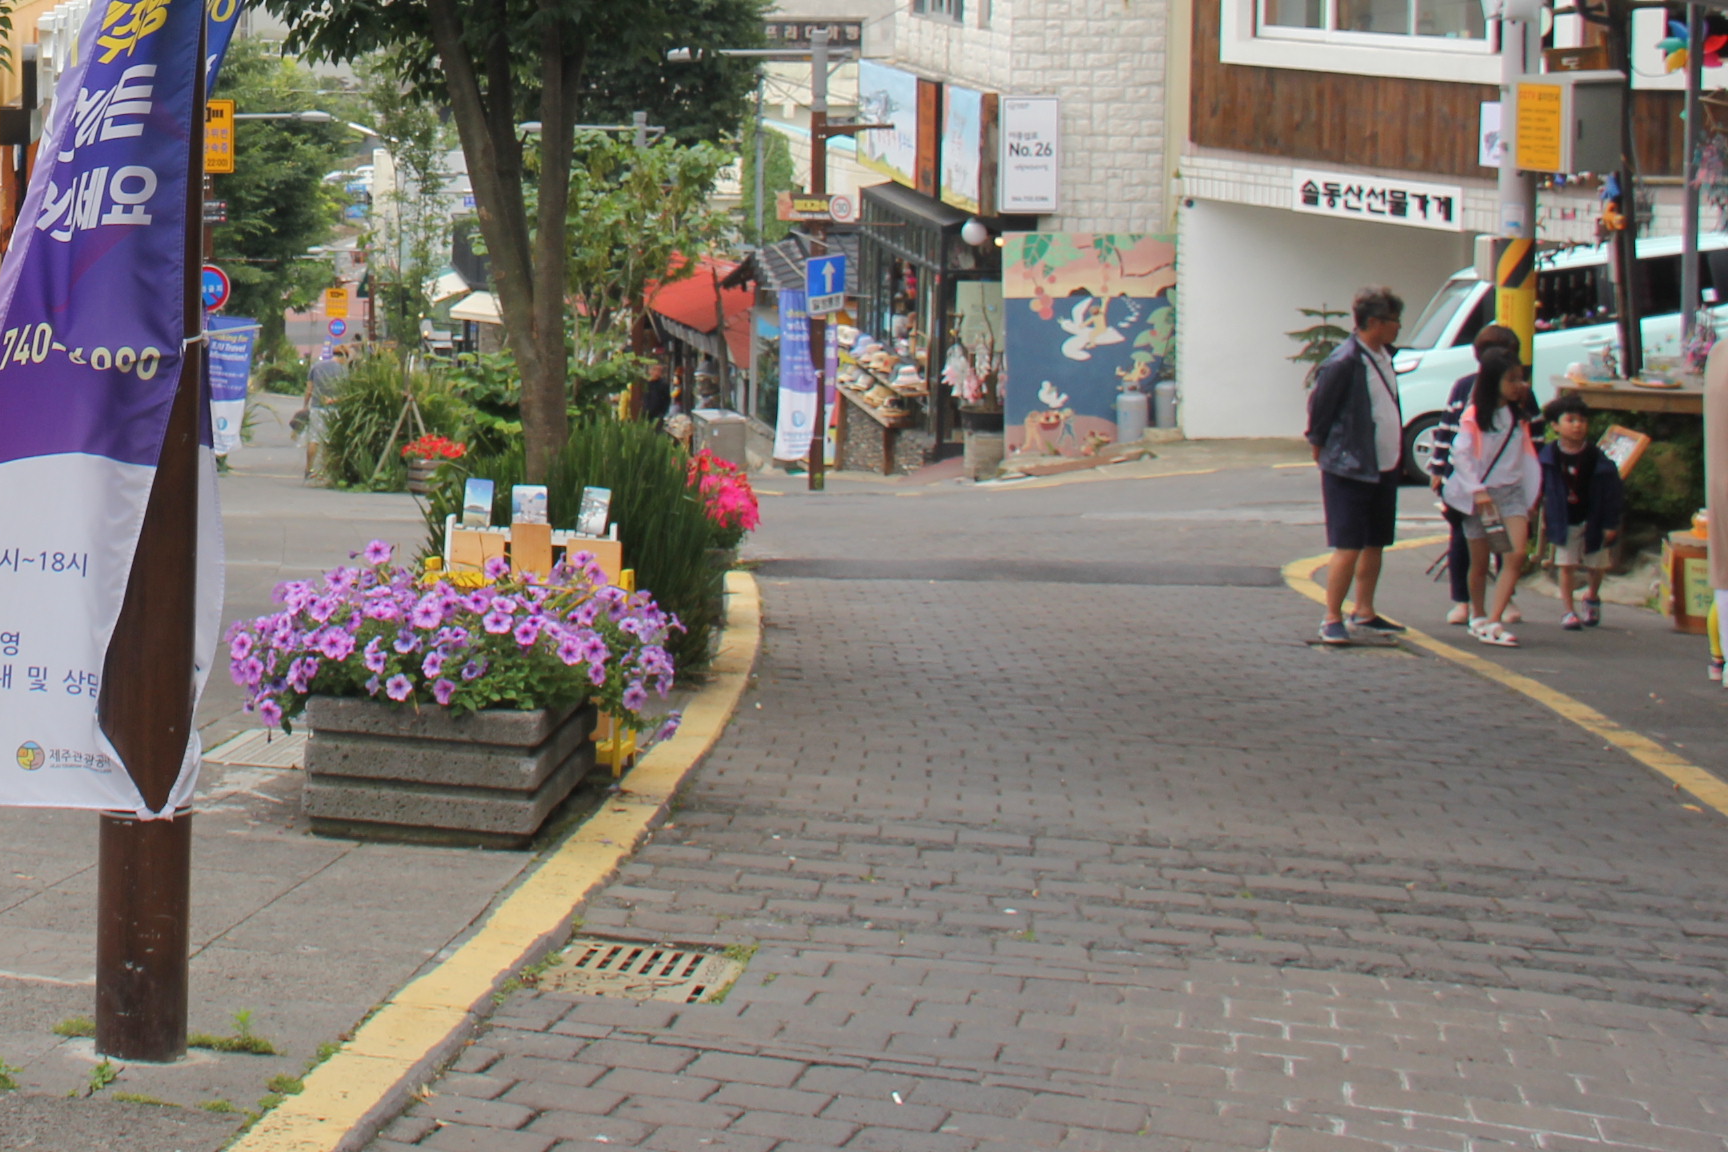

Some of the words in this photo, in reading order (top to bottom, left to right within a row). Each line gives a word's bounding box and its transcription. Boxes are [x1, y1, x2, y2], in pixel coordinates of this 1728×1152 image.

[1009, 142, 1032, 157] No.
[1035, 142, 1053, 157] 26
[1300, 179, 1454, 223] 솔동산선물가게
[28, 665, 48, 693] 및
